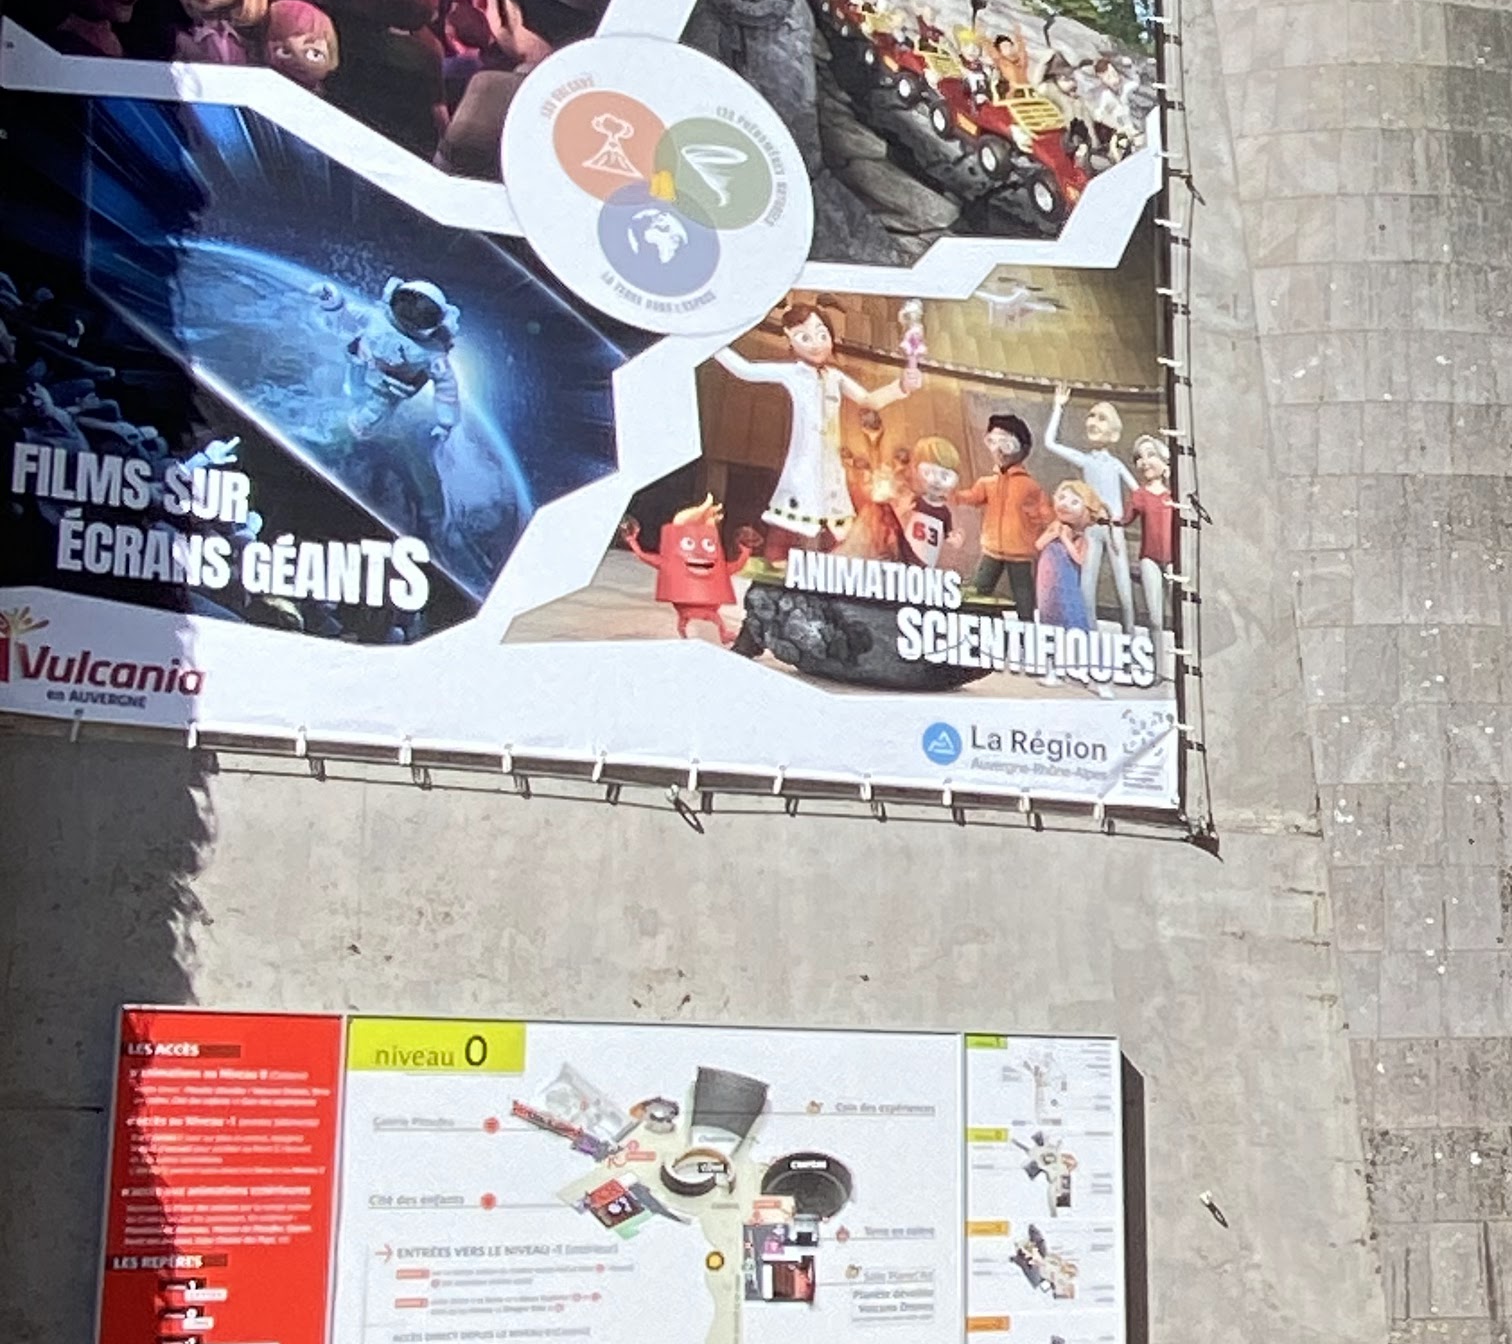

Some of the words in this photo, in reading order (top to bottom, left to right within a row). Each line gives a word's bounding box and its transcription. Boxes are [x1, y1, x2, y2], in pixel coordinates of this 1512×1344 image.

[11, 441, 152, 511] FILMS
[163, 462, 251, 524] SUR
[56, 507, 232, 590] ÉCRANS
[241, 533, 431, 612] GÉANTS
[785, 548, 963, 609] ANIMATIONS
[15, 641, 206, 697] Vulcania
[896, 606, 1156, 687] SCIENTIFIQUES
[69, 689, 148, 710] AUVERGNE
[970, 724, 1003, 752] La
[1010, 728, 1107, 763] Région
[374, 1045, 455, 1067] niveau
[464, 1035, 488, 1067] 0
